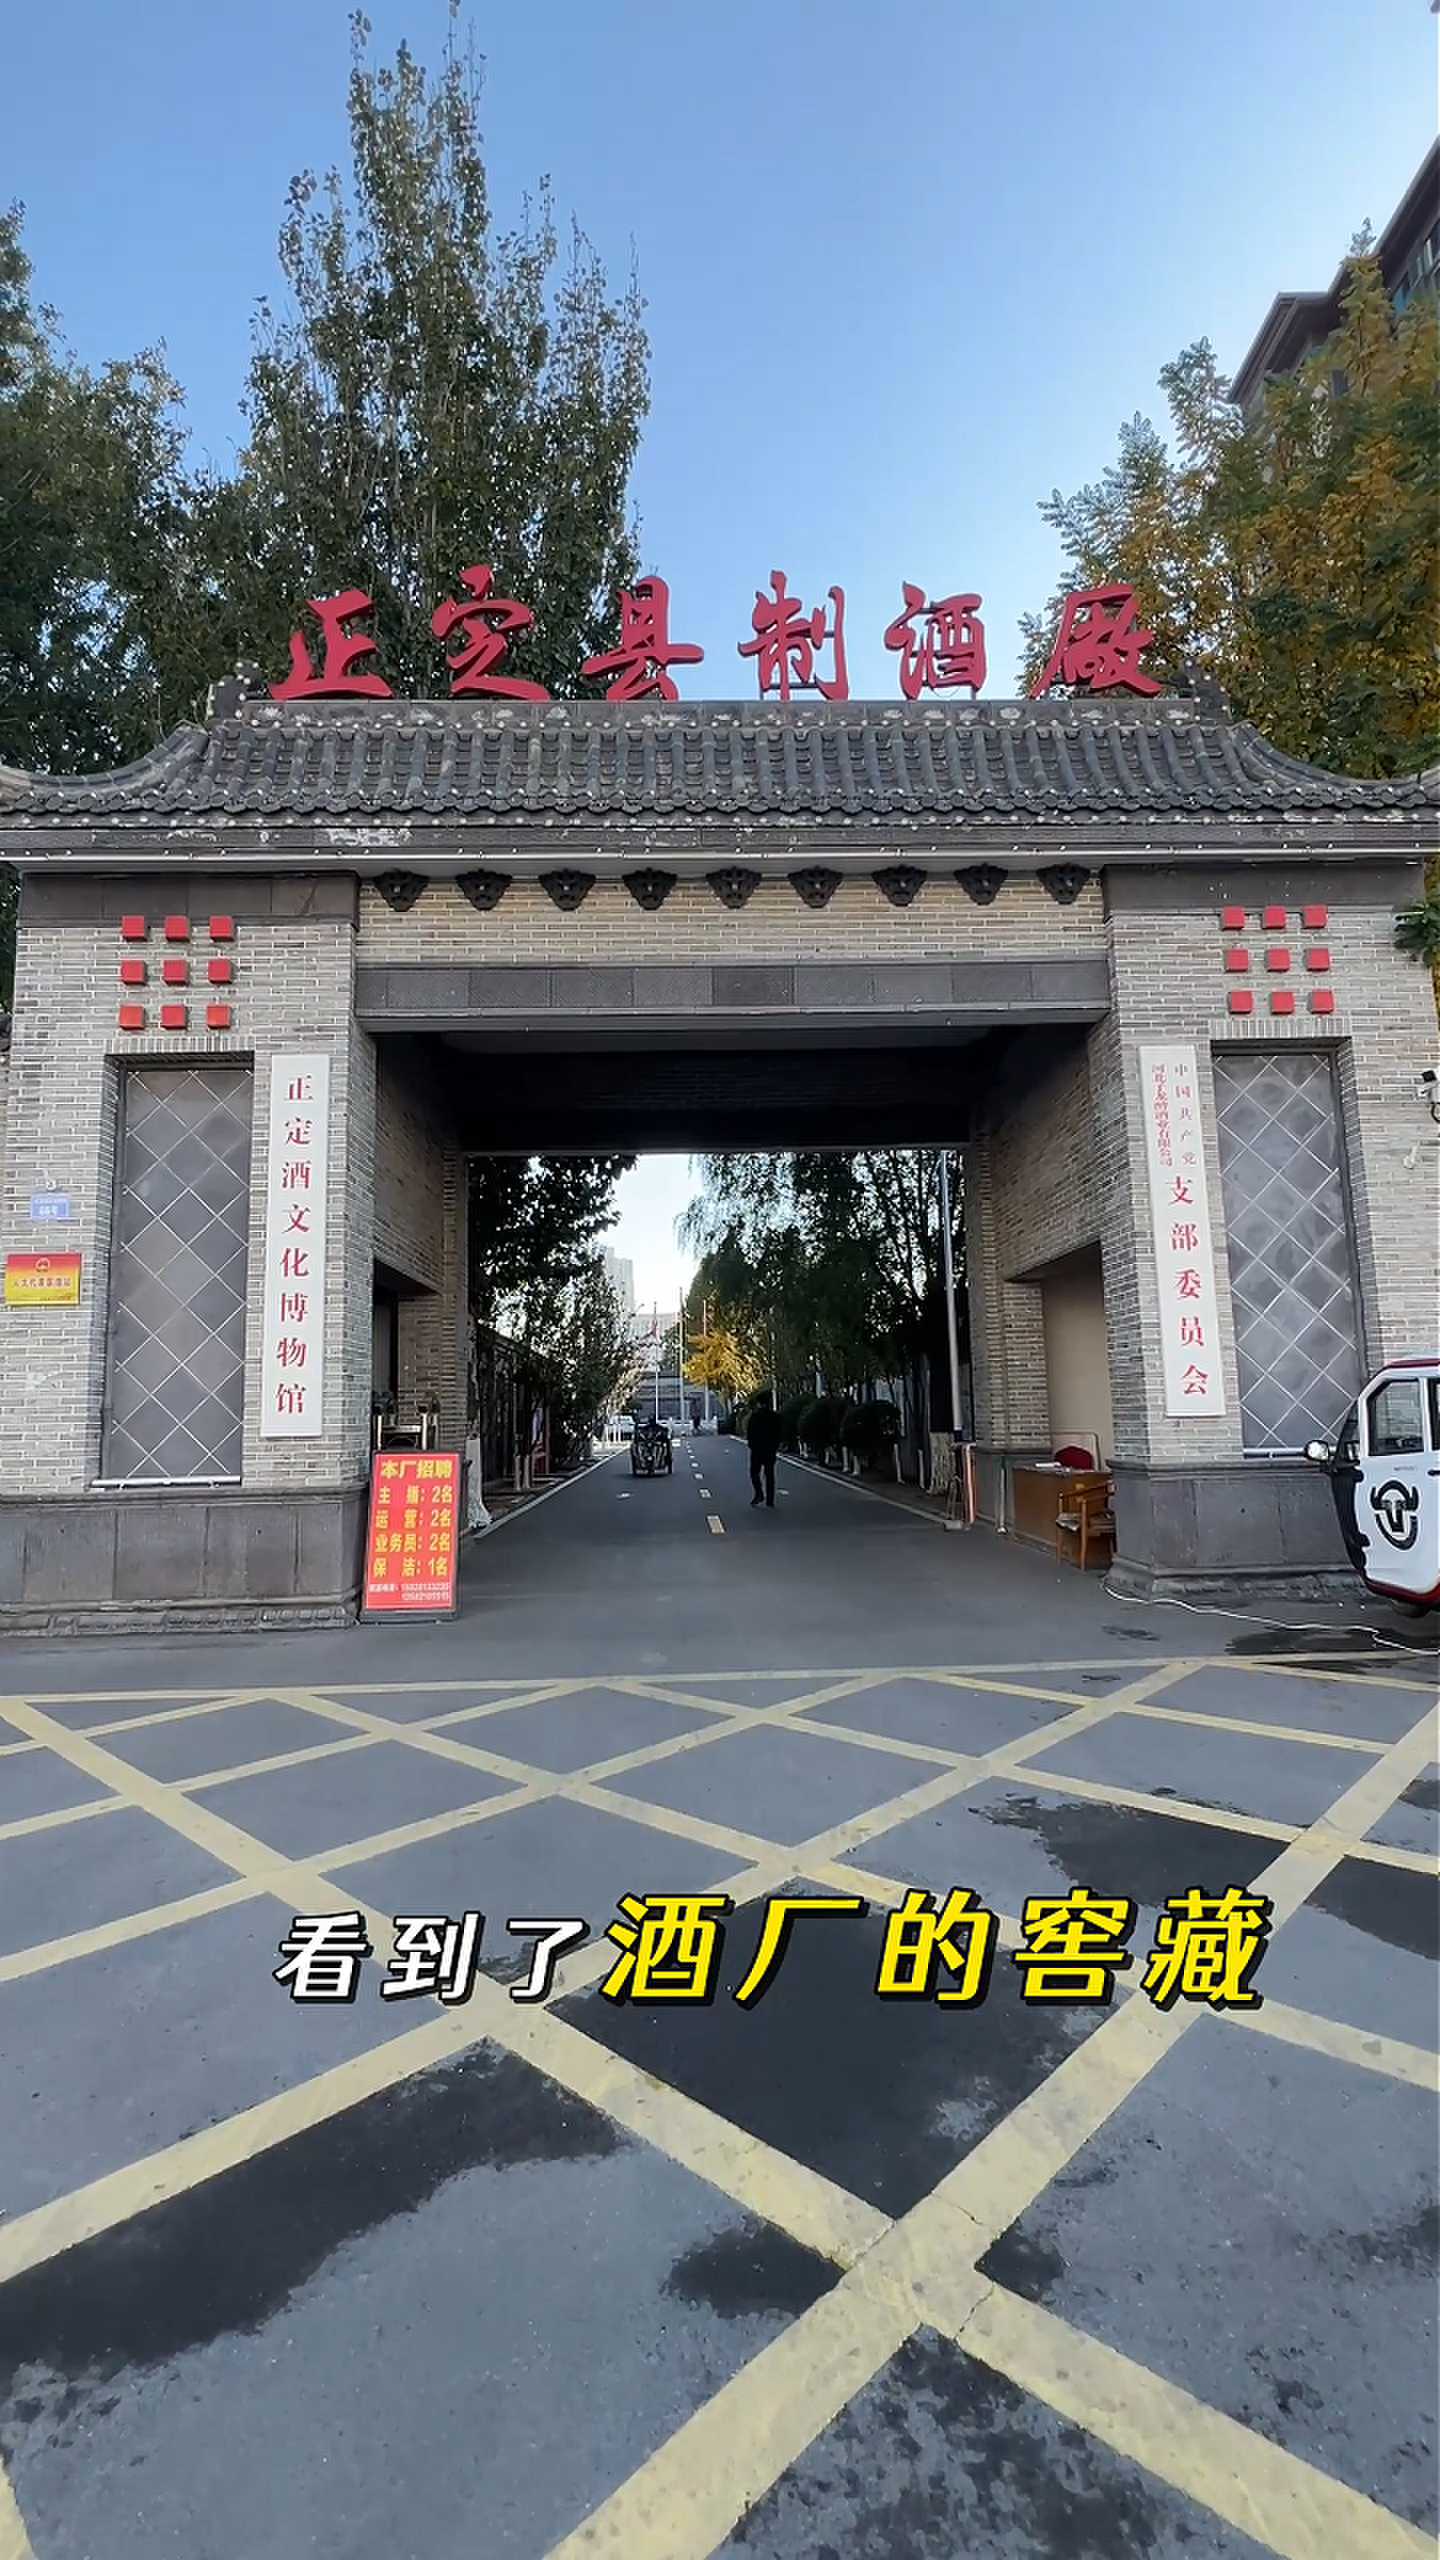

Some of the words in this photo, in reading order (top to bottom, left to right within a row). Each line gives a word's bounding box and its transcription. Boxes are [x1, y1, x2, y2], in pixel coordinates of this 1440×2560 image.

[1174, 1063, 1196, 1165] 中国共产党
[275, 1074, 313, 1414] 正定酒文化博物馆
[1165, 1175, 1208, 1395] 支部委员会
[380, 1459, 453, 1479] 本厂招聘
